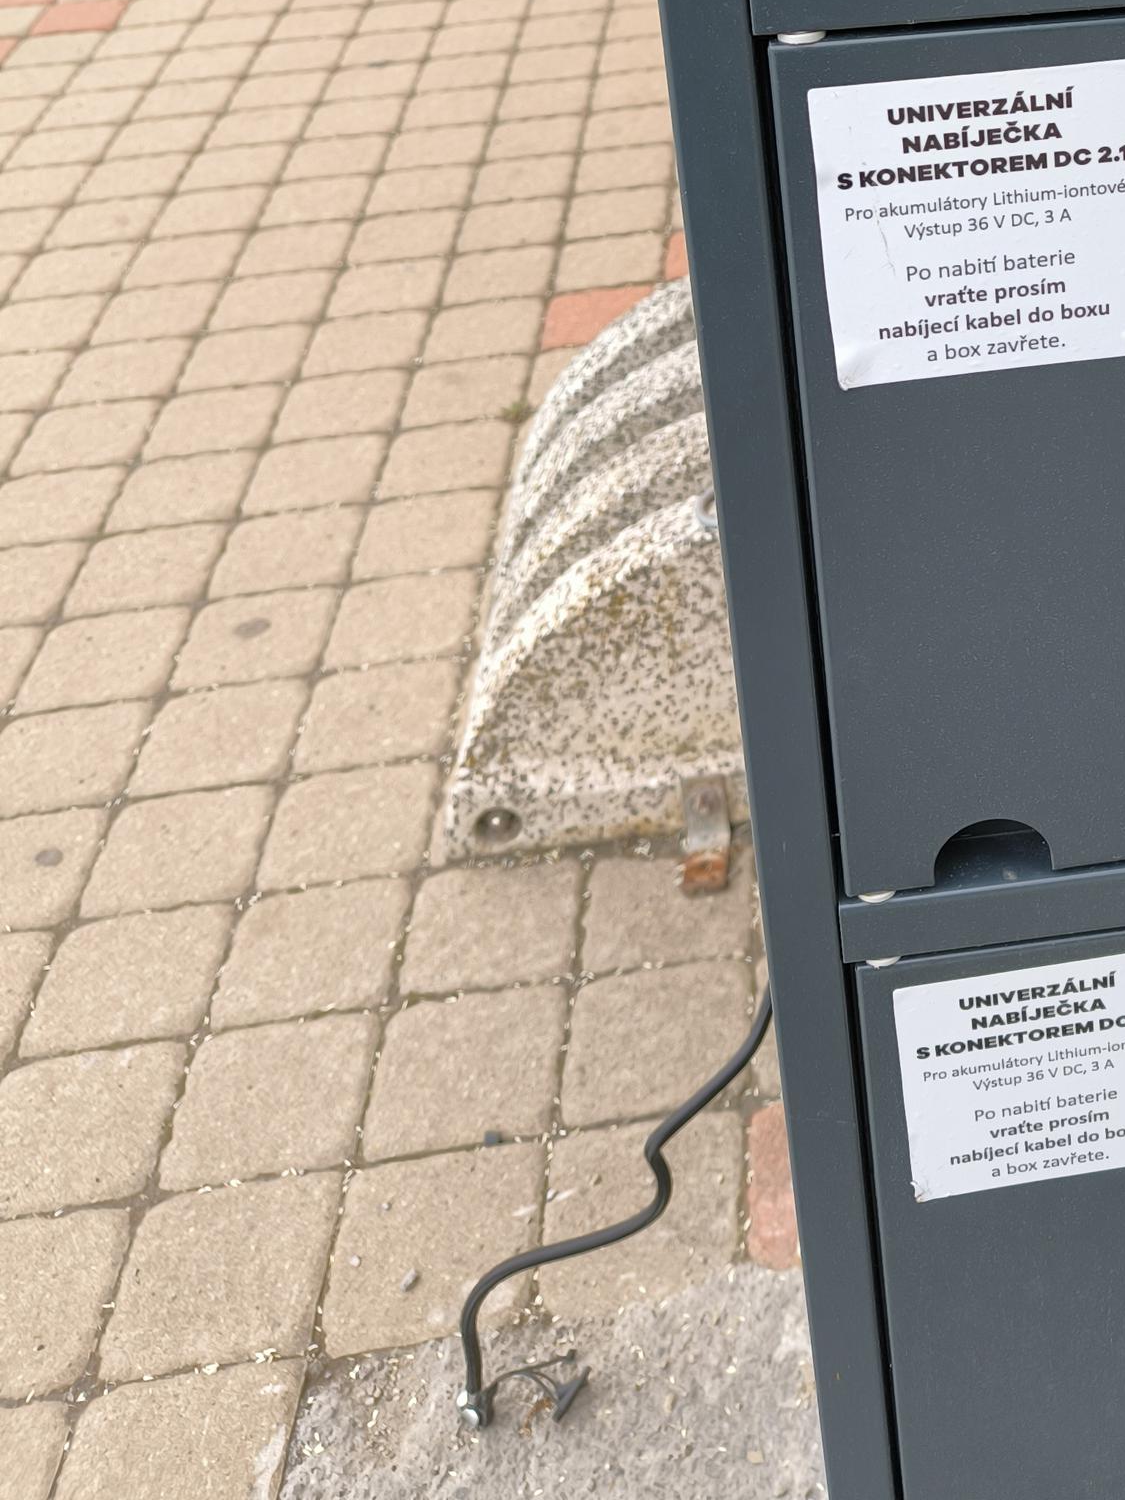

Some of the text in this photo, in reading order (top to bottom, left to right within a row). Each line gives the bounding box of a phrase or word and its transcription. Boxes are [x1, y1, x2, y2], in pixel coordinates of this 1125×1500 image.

[887, 85, 1074, 125] UNIVERZÁLNÍ
[901, 120, 1062, 154] NABÍJEČKA
[837, 172, 853, 190] S
[858, 152, 1048, 188] KONEKTOREM
[1053, 148, 1092, 168] DC
[844, 178, 1125, 222] Pro akumulátory Lithium-iontové
[903, 208, 1072, 241] Výstup 36 V DC, 3 A
[906, 249, 1075, 282] Po nabití baterie
[924, 277, 1066, 307] vraťte prosím
[878, 303, 1110, 340] nabíjecí kabel do boxu
[927, 334, 1065, 362] a box zavřete.
[958, 970, 1116, 1010] UNIVERZÁLNÍ
[971, 998, 1106, 1030] NABÍJEČKA
[916, 1046, 930, 1060] S
[934, 1020, 1094, 1057] KONEKTOREM
[923, 1071, 947, 1082] Pro
[951, 1055, 1043, 1077] akumulátory
[972, 1058, 1114, 1091] Výstup 36 V DC, 3 A
[974, 1088, 1117, 1122] Po nabití baterie
[989, 1109, 1109, 1139] vraťte prosím
[950, 1141, 1019, 1165] nabíjecí
[1024, 1133, 1071, 1153] kabel
[1077, 1131, 1099, 1144] do
[991, 1151, 1109, 1177] a box zavřete.
